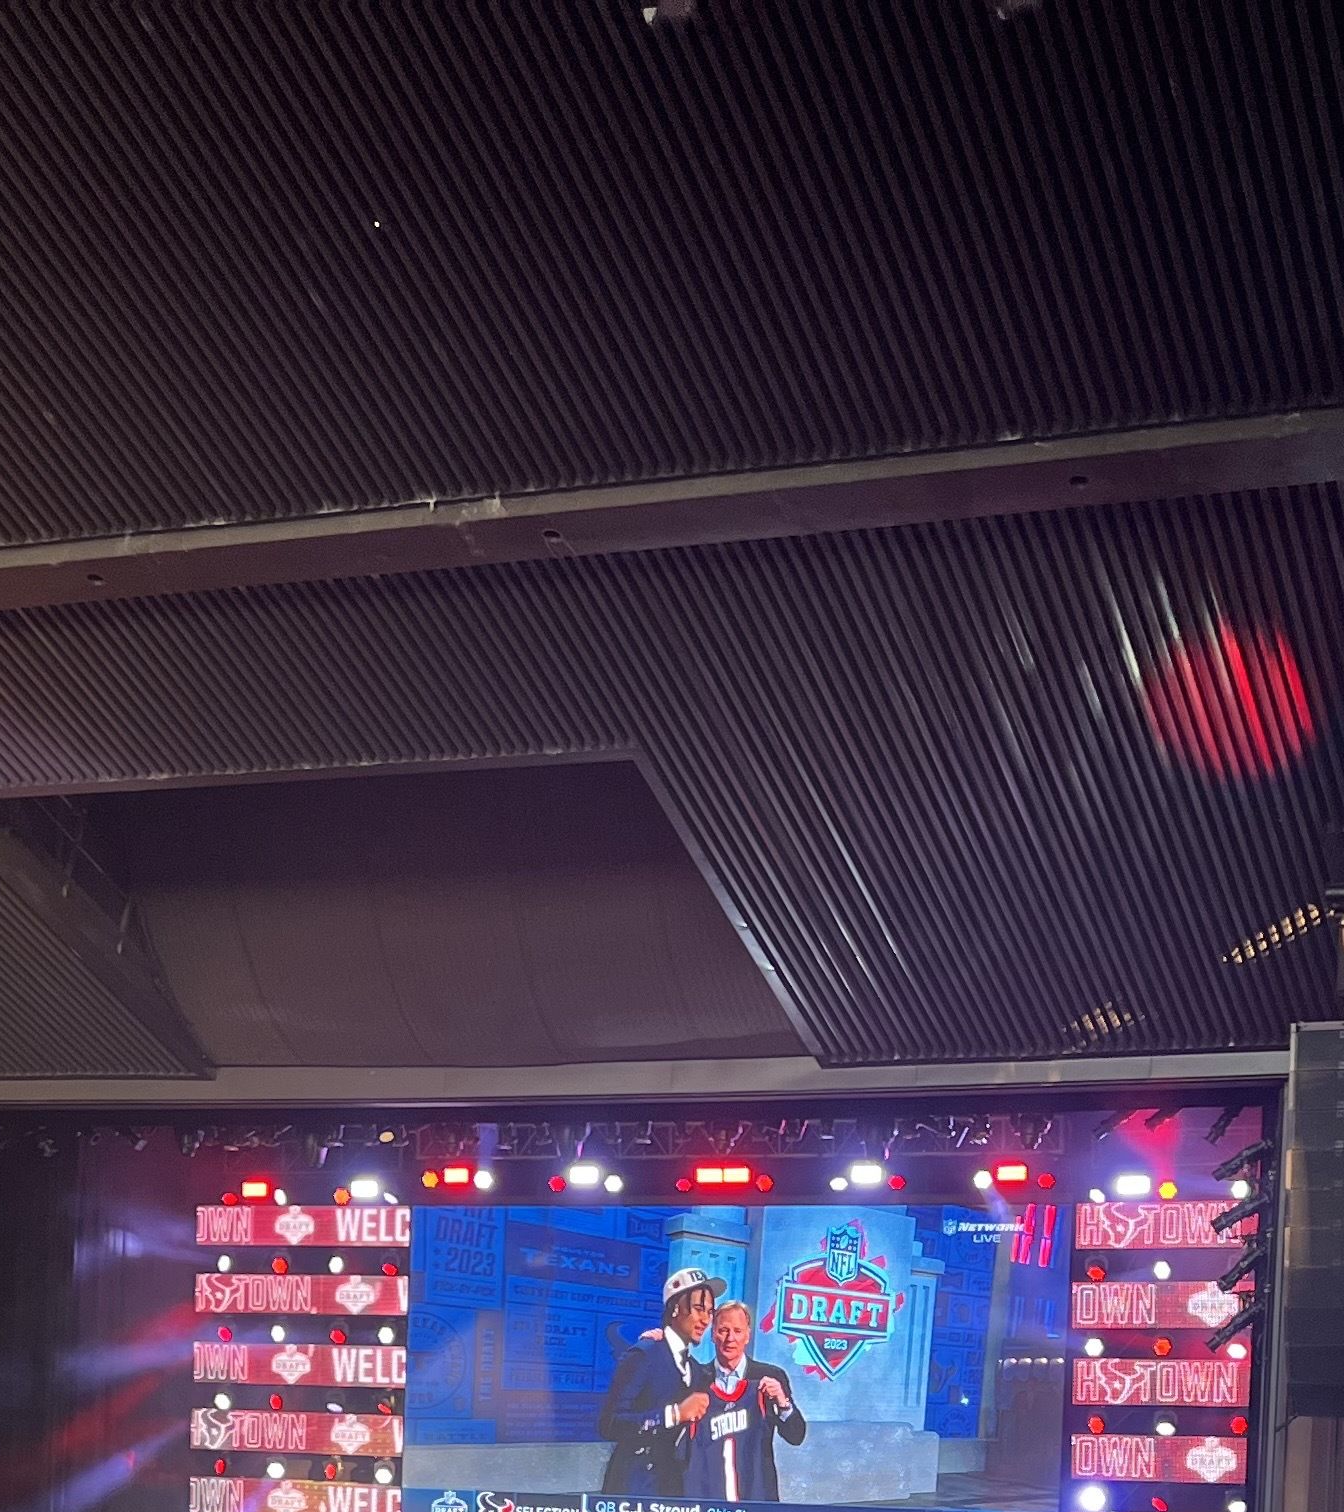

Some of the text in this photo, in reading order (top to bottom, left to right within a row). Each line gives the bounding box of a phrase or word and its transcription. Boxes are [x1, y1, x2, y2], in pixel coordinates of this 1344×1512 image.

[436, 1216, 496, 1249] DRAFT
[958, 1222, 1024, 1232] NETWORK
[972, 1233, 1001, 1244] LIVE
[445, 1249, 496, 1277] 2023
[520, 1247, 630, 1278] TEXANS
[829, 1251, 854, 1278] NFL
[790, 1293, 883, 1328] DRAFT
[824, 1338, 848, 1351] 2023
[710, 1409, 748, 1441] STROUD
[722, 1437, 739, 1502] 1
